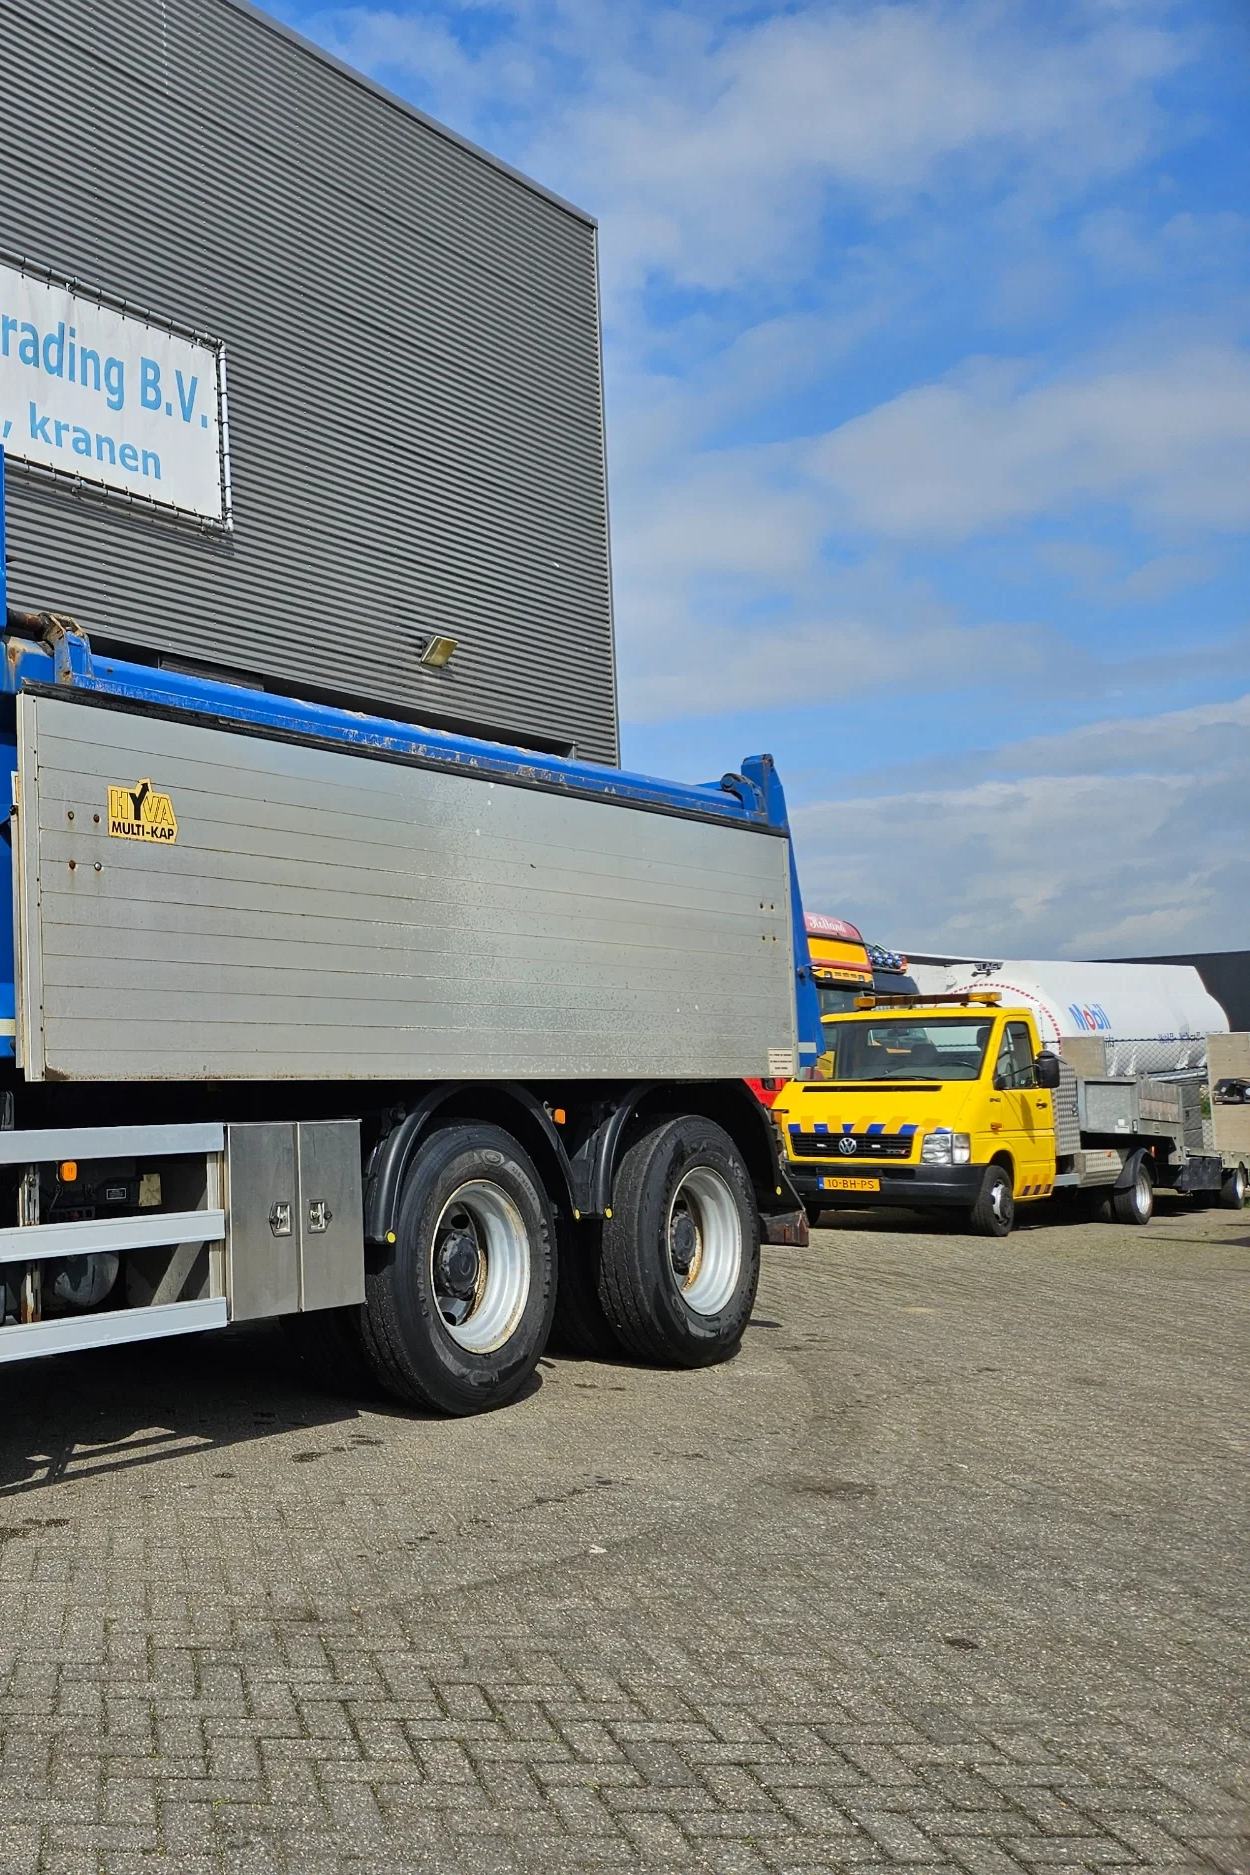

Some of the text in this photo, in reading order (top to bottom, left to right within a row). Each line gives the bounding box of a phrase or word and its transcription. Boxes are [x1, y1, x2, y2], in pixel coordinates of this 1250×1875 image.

[140, 358, 207, 428] B.V.
[29, 402, 162, 480] kranen
[110, 782, 175, 826] HYVA
[111, 821, 174, 840] MULTI-KAP
[1068, 1003, 1112, 1031] Mobil
[827, 1178, 875, 1189] 10-BH-PS
